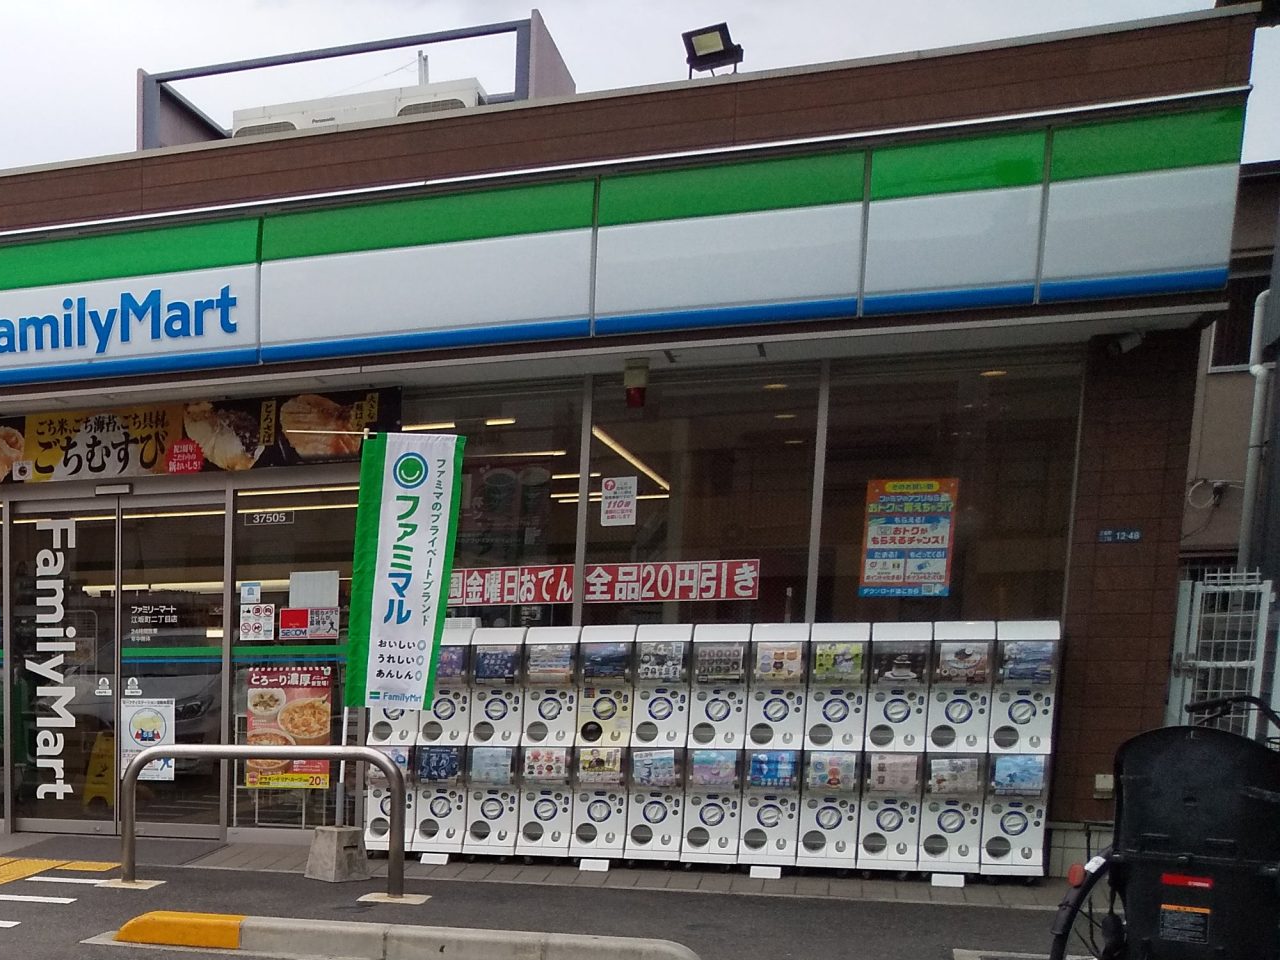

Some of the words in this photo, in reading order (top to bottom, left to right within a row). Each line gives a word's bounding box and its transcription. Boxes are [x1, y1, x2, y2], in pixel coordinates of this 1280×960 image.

[34, 430, 170, 476] ごちむすび
[252, 512, 286, 524] 37505
[421, 458, 446, 627] ファミマのプライベートブランド
[383, 494, 420, 625] ファミマル
[585, 562, 759, 602] 全品20円引き
[131, 604, 177, 614] ファミリーマート
[280, 628, 308, 636] SECOM
[378, 639, 416, 650] おいしい
[25, 518, 76, 800] FamilyMart
[377, 654, 415, 665] うれしい
[376, 669, 413, 680] あんしん
